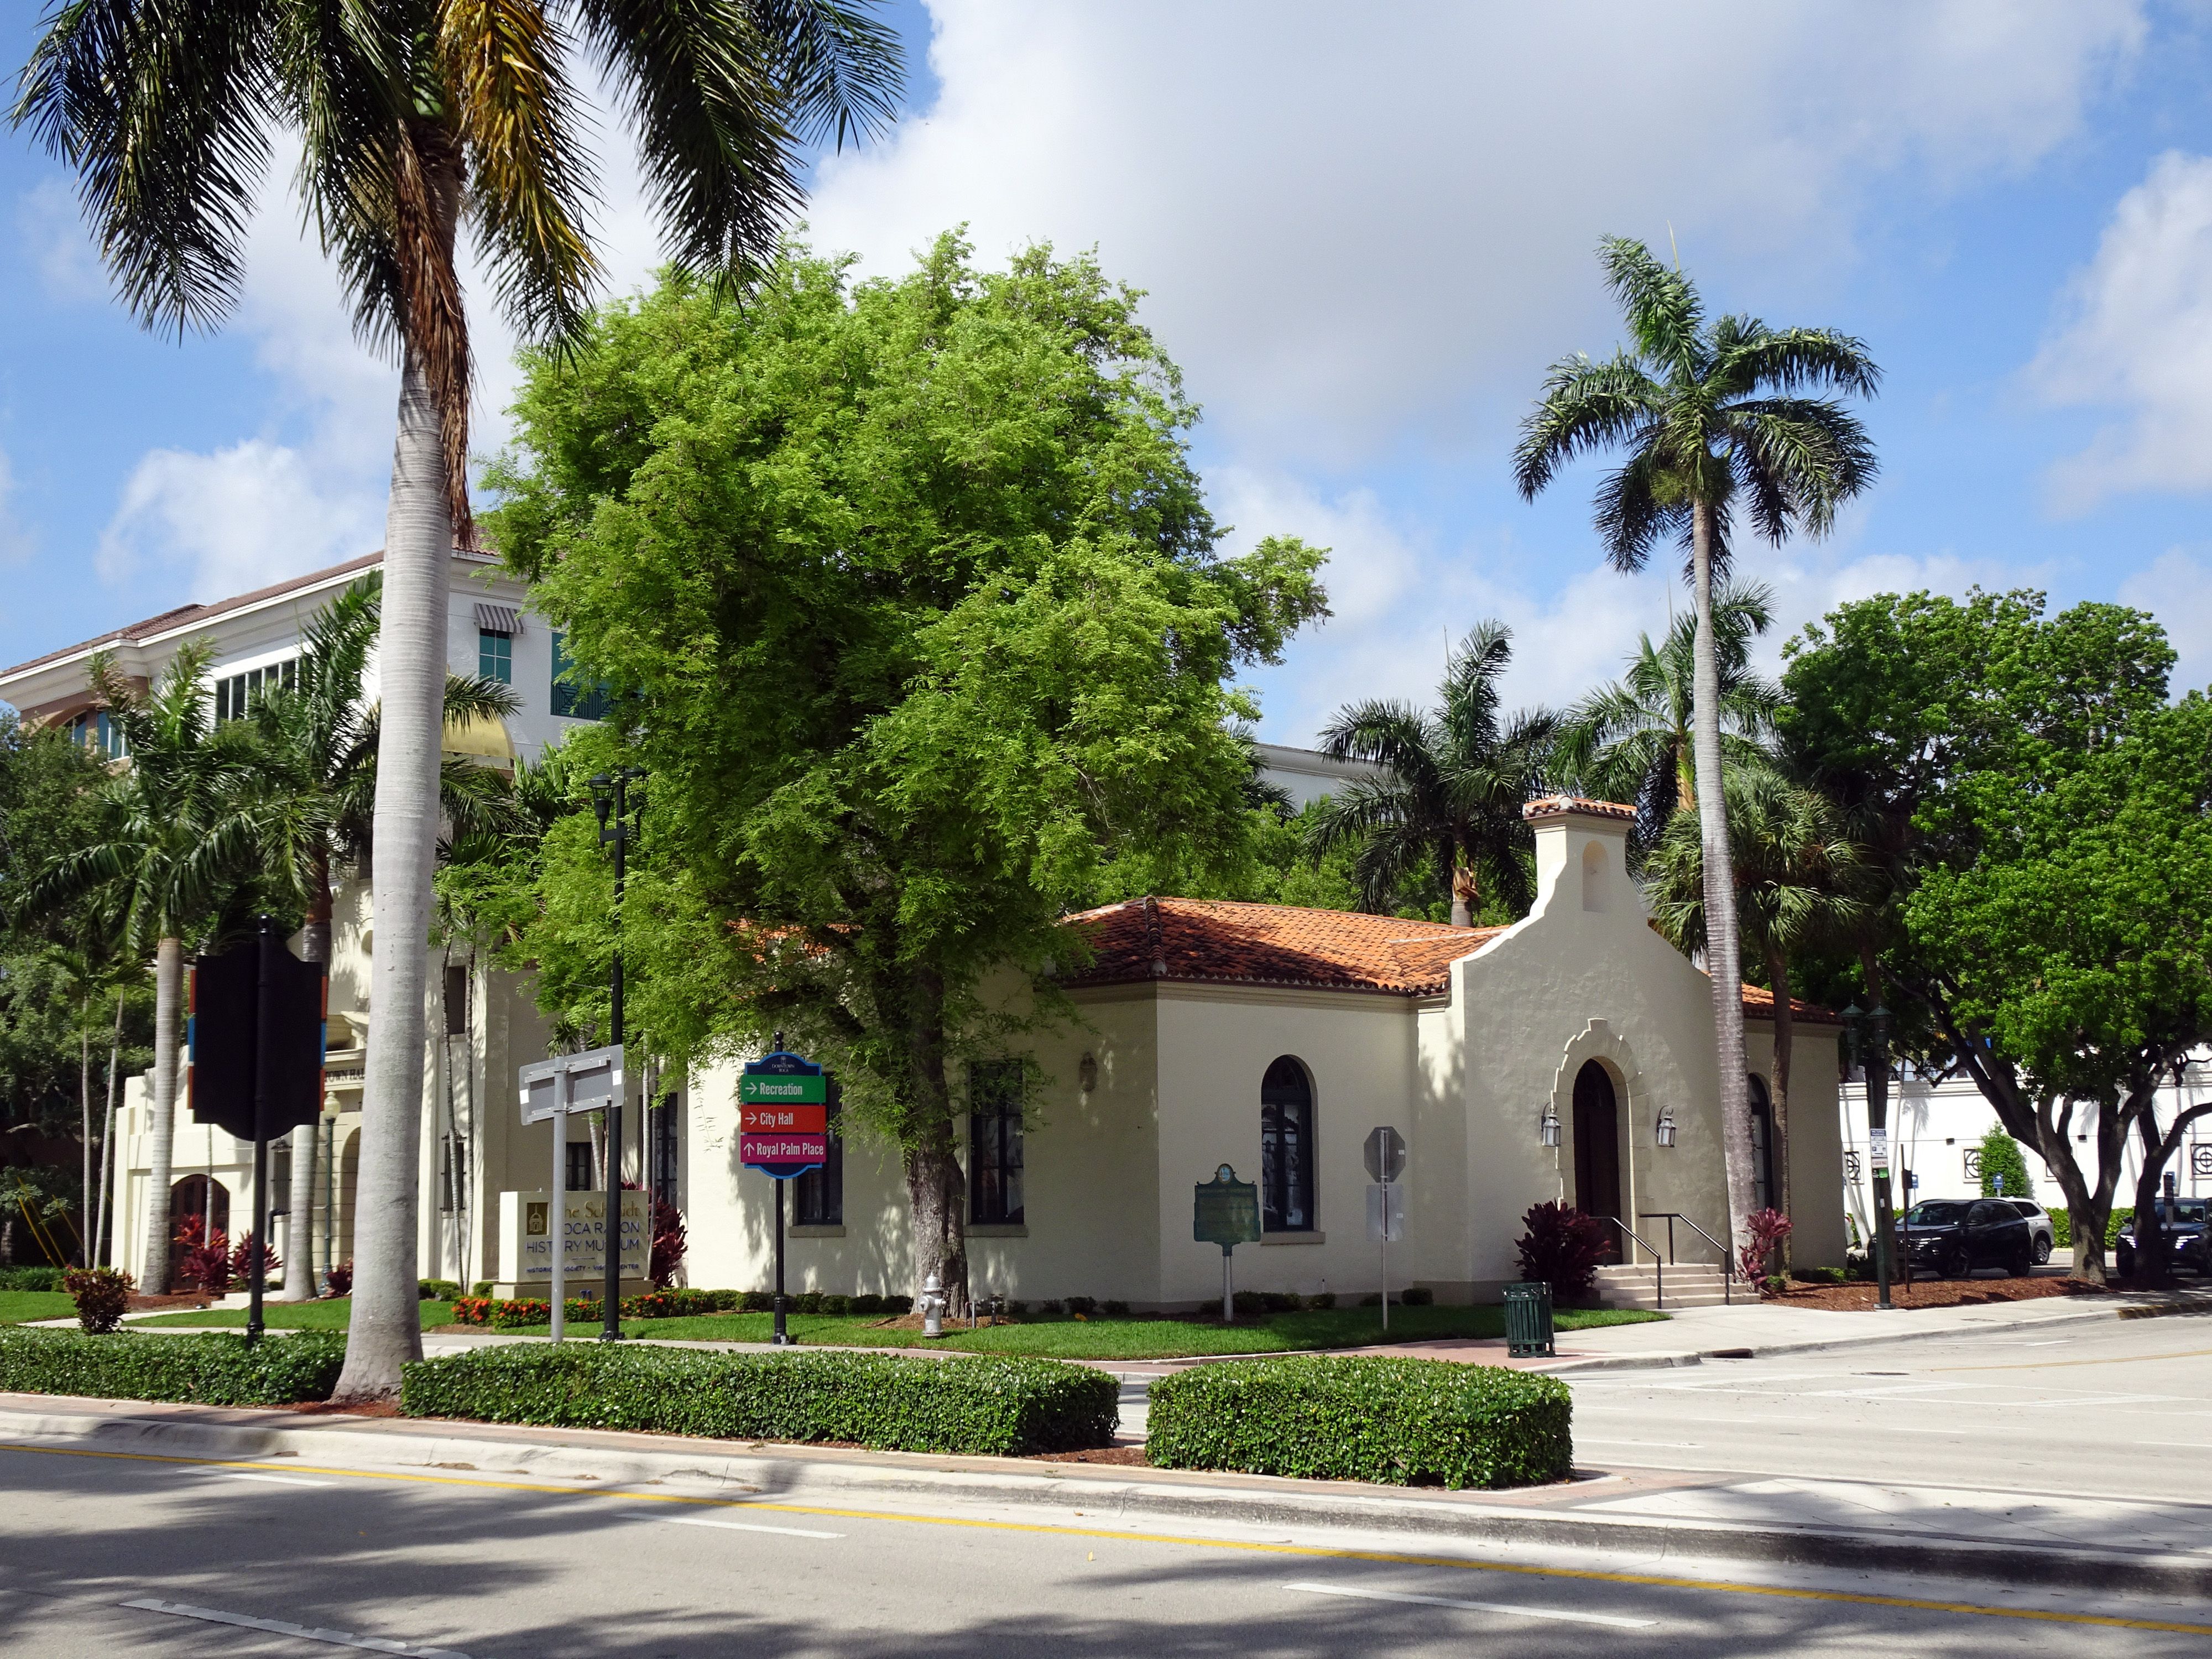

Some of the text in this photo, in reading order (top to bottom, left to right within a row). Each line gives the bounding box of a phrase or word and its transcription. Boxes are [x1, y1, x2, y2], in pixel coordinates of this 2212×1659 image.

[760, 1082, 802, 1095] Recreation
[760, 1112, 794, 1128] City Hall
[757, 1142, 823, 1158] Royal Palm Place
[565, 1200, 640, 1218] he Schidt
[564, 1220, 639, 1235] OCA RON
[526, 1239, 639, 1253] HISTRY MUUM
[580, 1290, 592, 1301] 71
